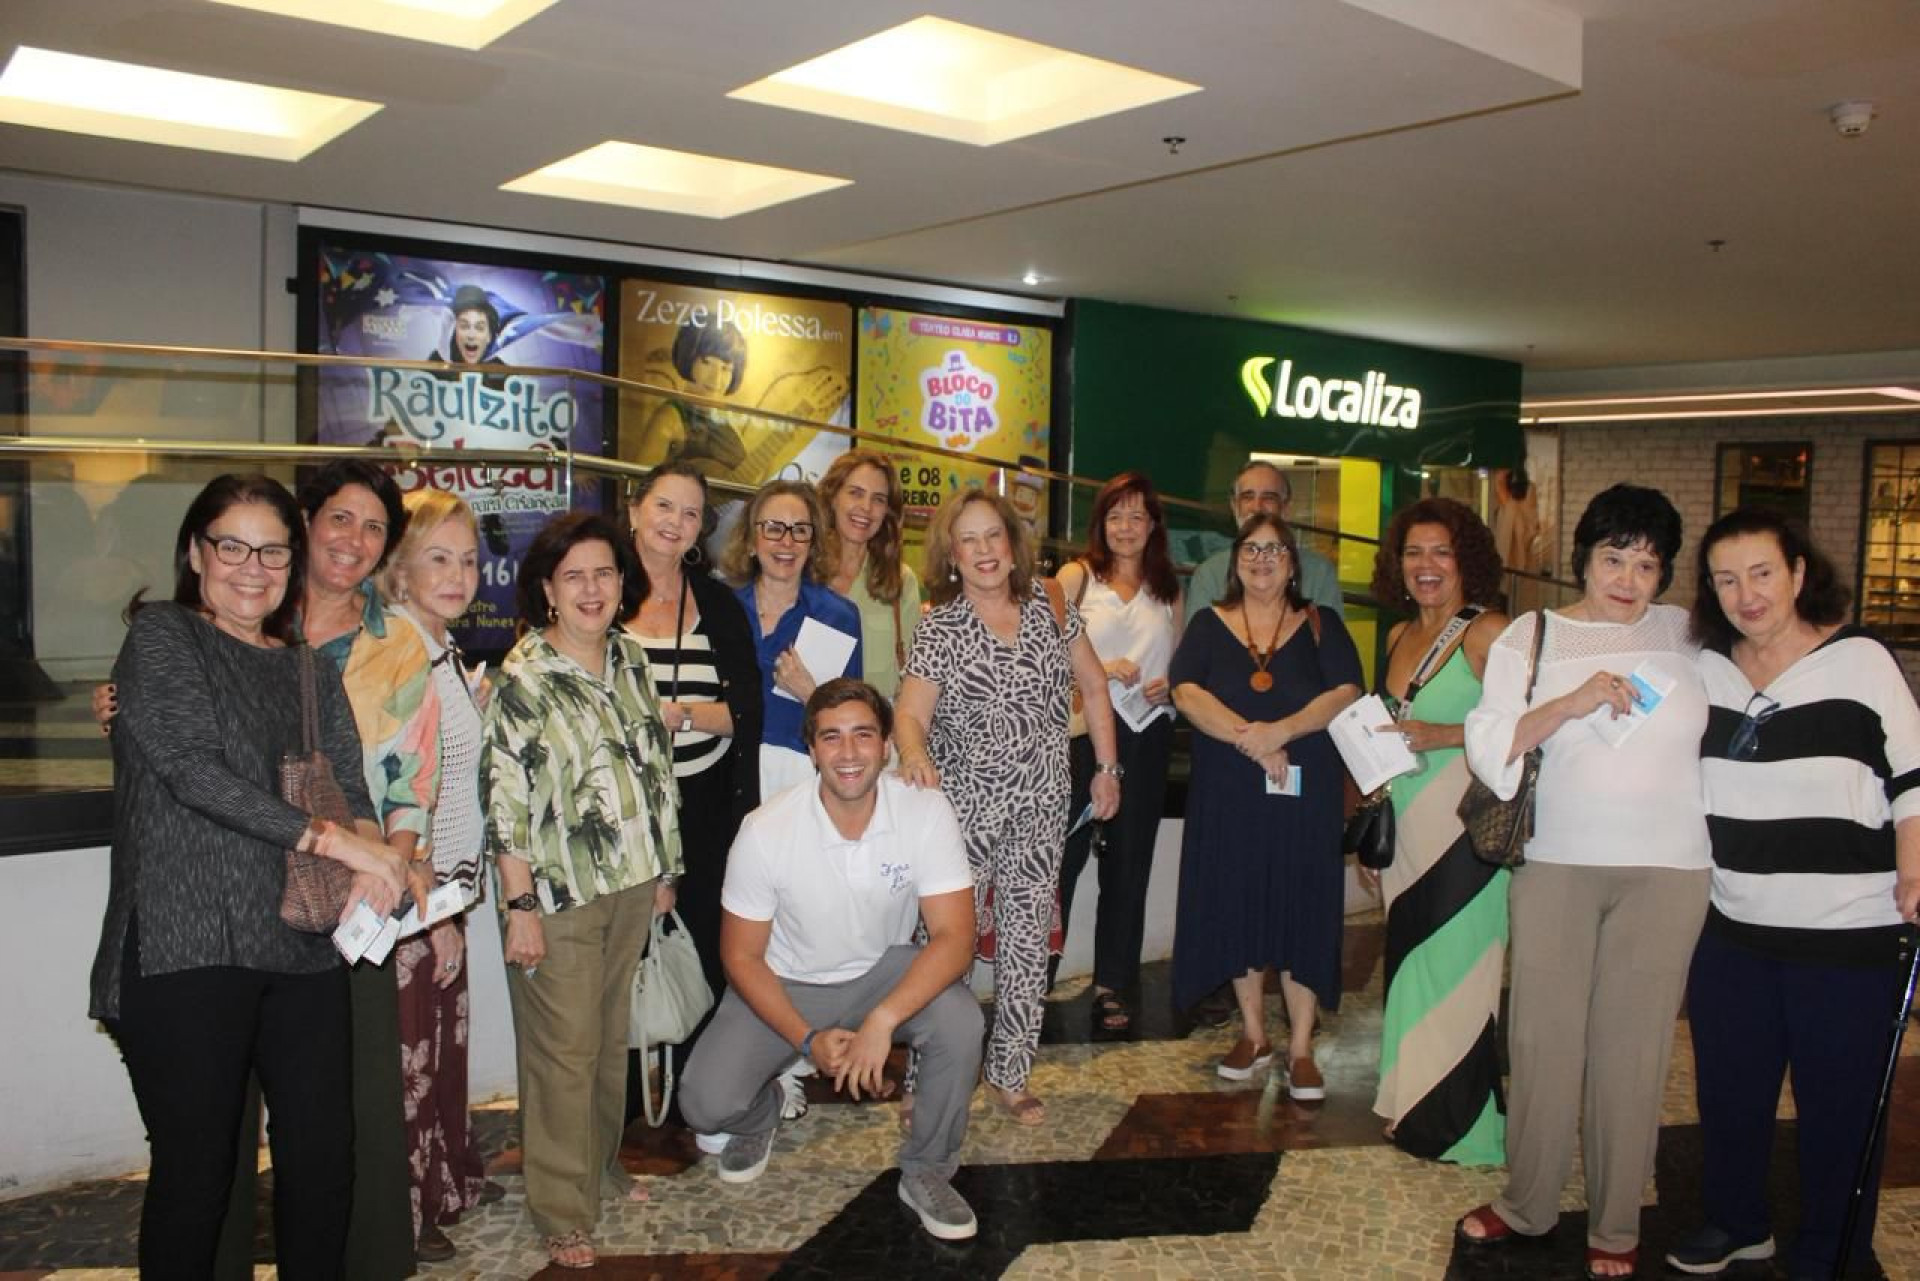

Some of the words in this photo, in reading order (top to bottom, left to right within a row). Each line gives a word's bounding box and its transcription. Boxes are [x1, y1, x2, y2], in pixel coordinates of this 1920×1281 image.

[637, 291, 709, 328] Zeze
[716, 298, 821, 340] Polessa
[822, 330, 844, 343] em
[371, 368, 573, 441] Raulzito
[926, 374, 994, 400] BLOCO
[1274, 358, 1422, 429] Localiza
[918, 467, 941, 487] 08
[901, 489, 940, 506] REIRO
